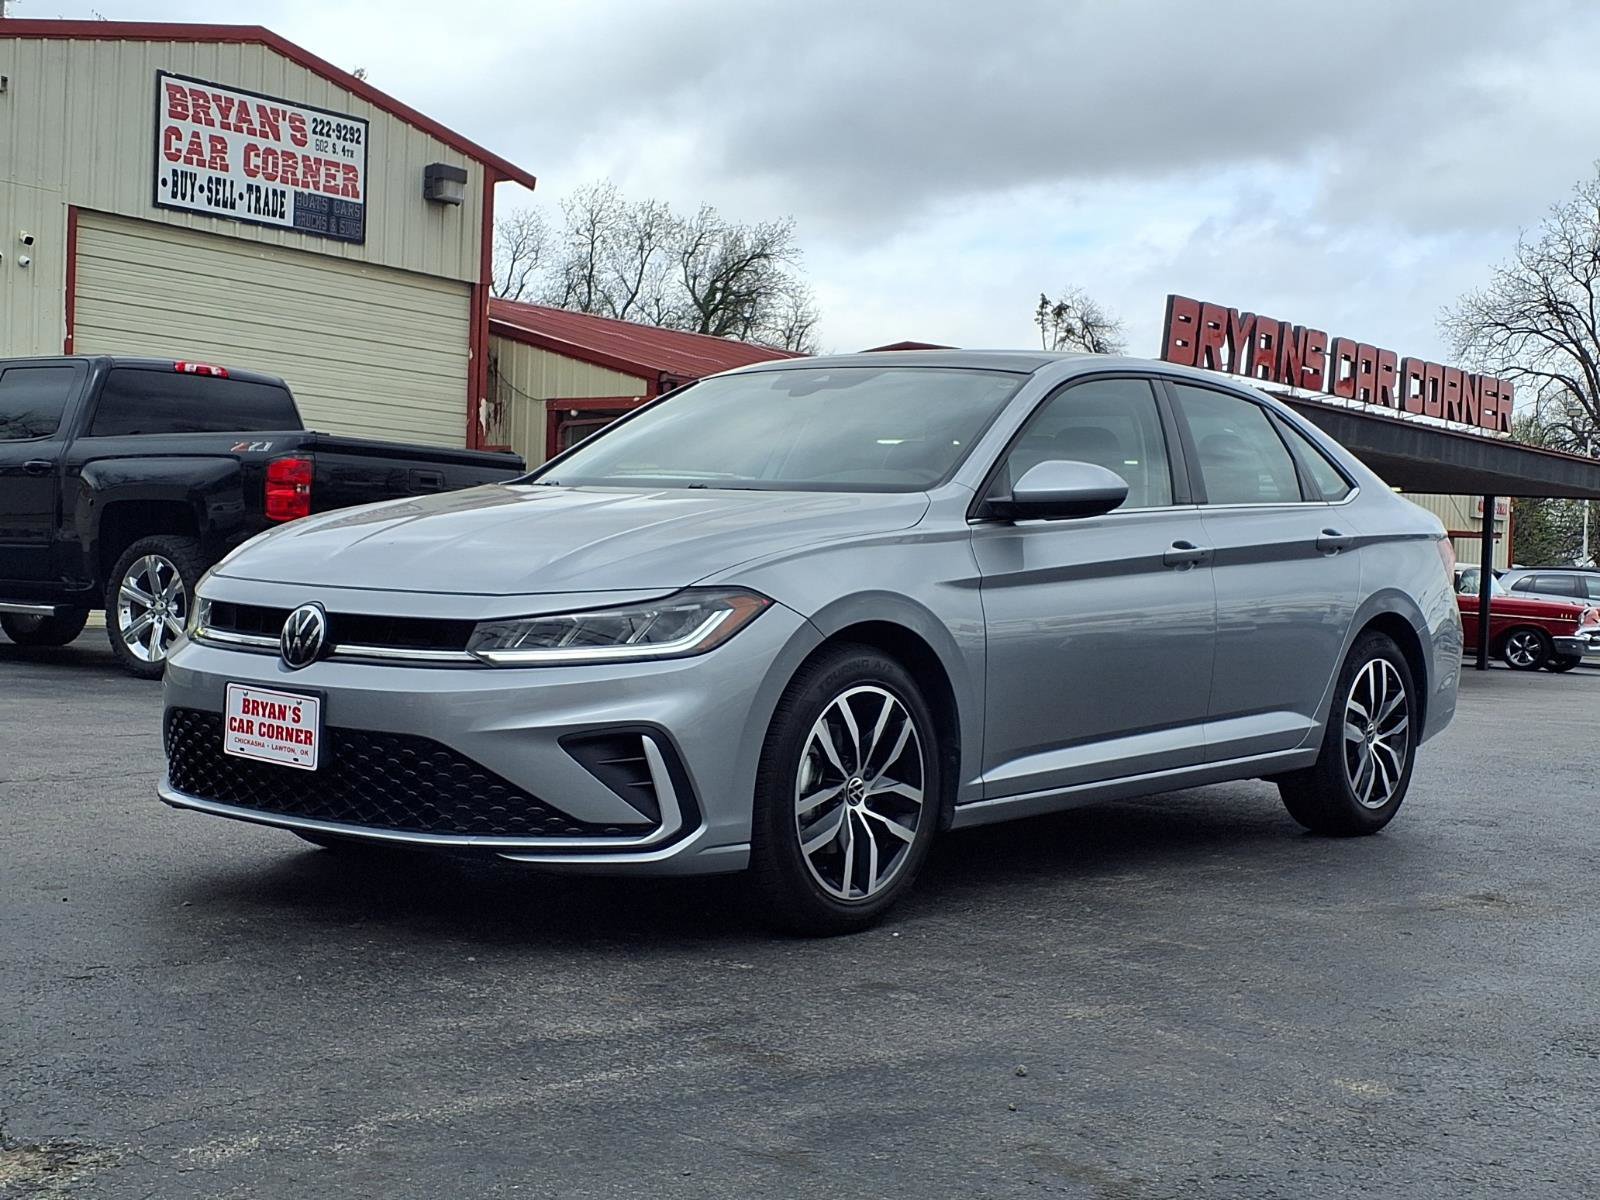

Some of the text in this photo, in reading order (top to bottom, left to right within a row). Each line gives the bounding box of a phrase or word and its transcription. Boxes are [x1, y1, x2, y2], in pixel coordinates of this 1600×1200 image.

[166, 83, 309, 148] BRYAN'S
[312, 117, 361, 145] 222-9292
[315, 138, 329, 153] 602
[332, 142, 339, 156] S.
[163, 125, 360, 199] CAR CORNER
[171, 169, 287, 219] BUY SELL TRADE
[295, 211, 328, 230] TRUCKS
[334, 200, 361, 218] CARS
[1162, 294, 1514, 433] BRYANS CAR CORNER
[230, 441, 273, 452] Z71
[241, 697, 302, 724] BRYAN'S
[229, 716, 314, 746] CAR CORNER
[234, 736, 265, 748] CHICKASHA
[300, 748, 309, 756] OK
